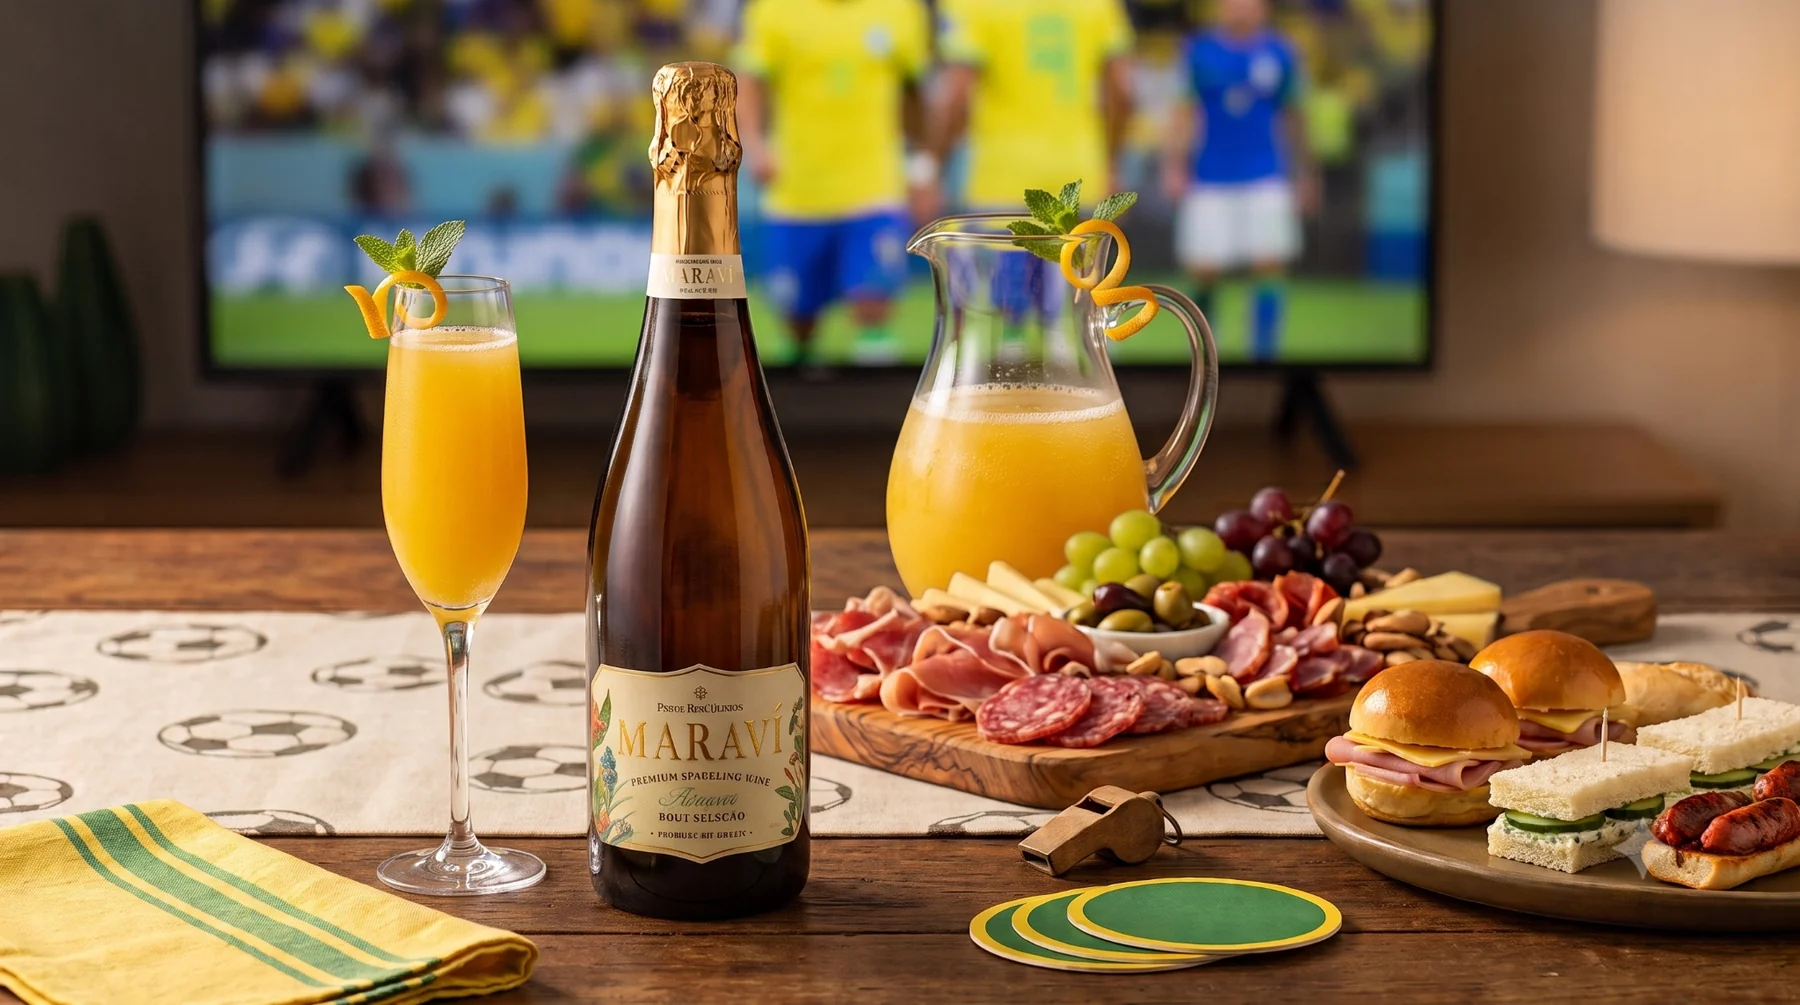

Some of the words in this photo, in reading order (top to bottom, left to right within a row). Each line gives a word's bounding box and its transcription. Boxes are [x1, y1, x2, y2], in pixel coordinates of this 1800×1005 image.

[618, 702, 783, 761] MARAVÍ
[631, 772, 678, 787] PREMIUM
[659, 812, 690, 823] BOUT
